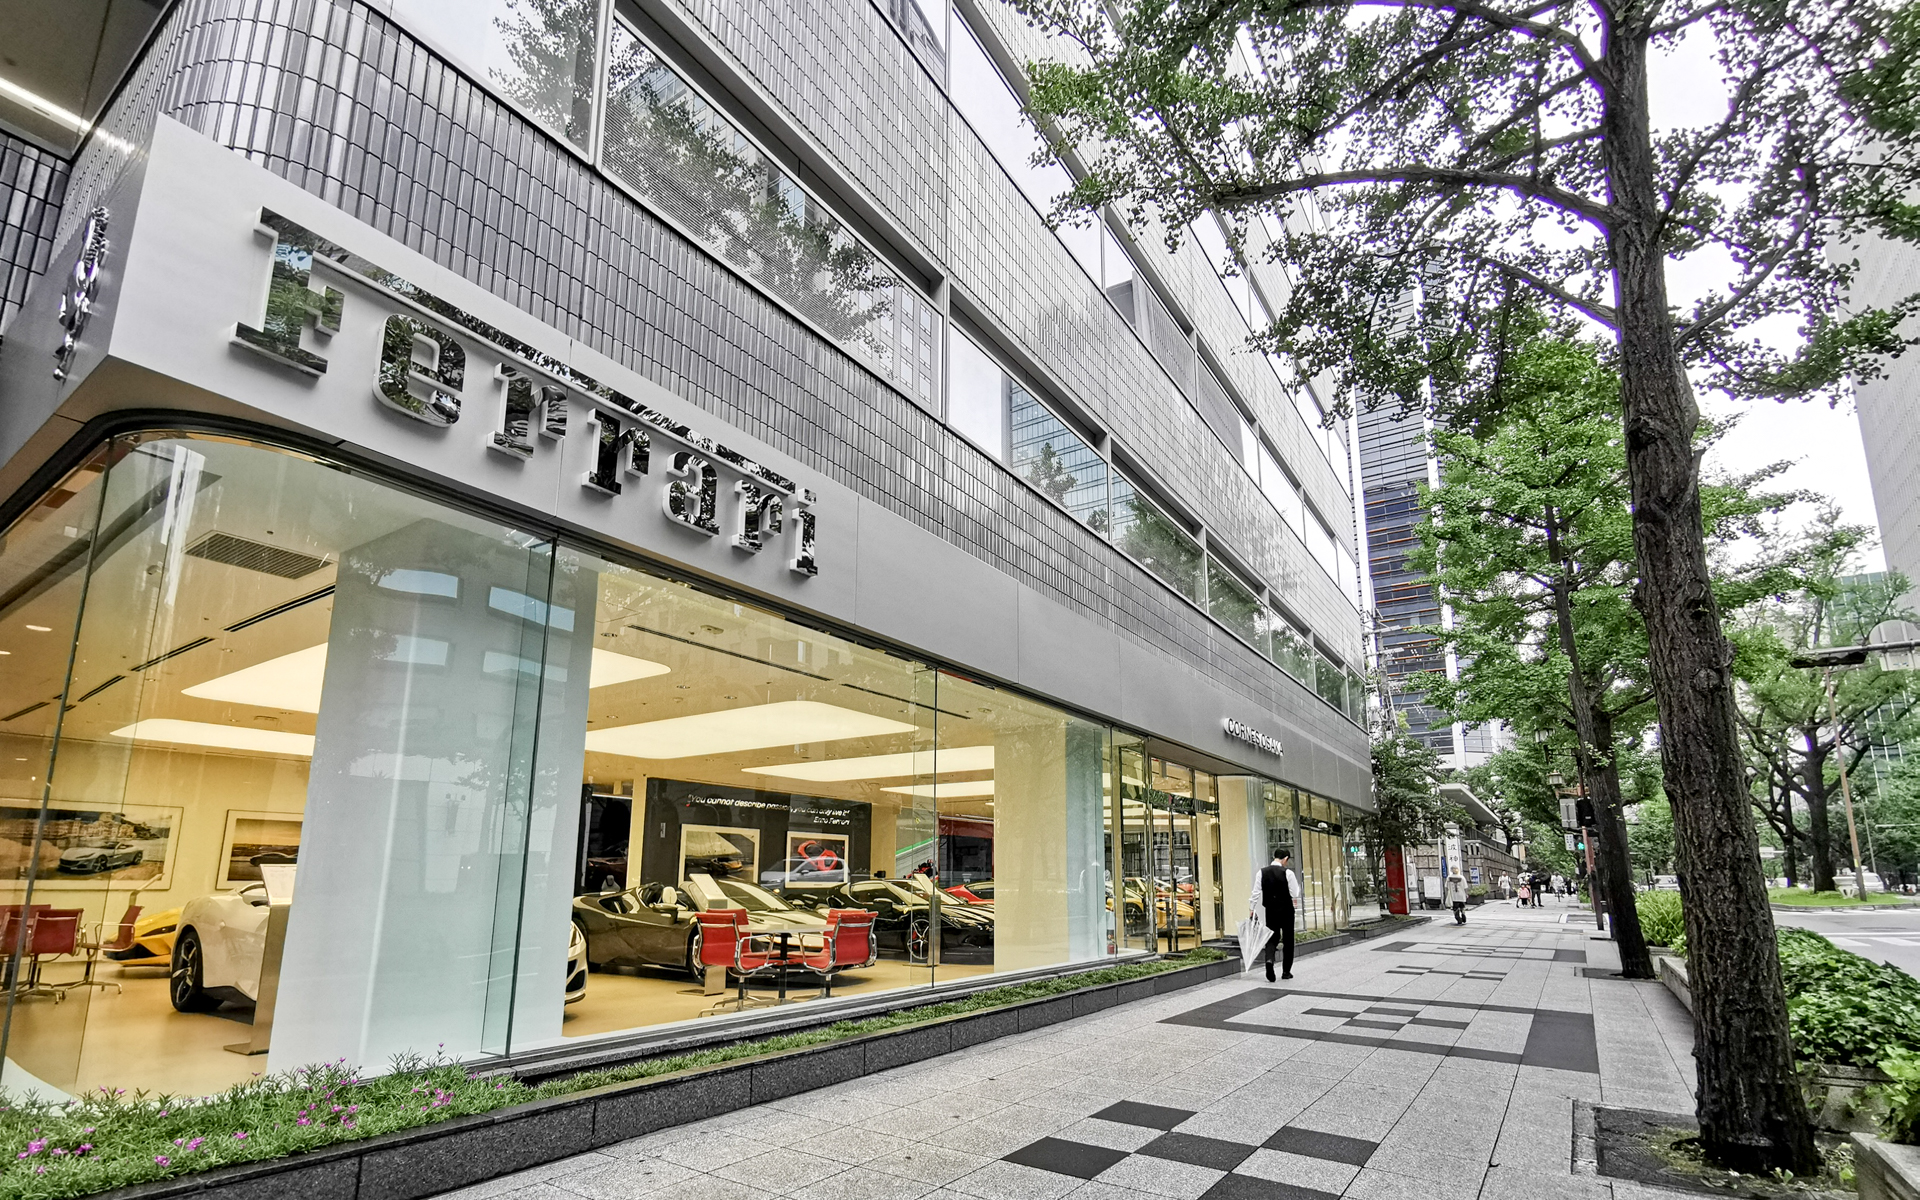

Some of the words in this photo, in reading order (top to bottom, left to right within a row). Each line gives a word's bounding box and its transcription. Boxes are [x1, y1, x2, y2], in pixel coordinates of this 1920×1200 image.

[229, 206, 819, 577] Ferrari
[1223, 717, 1260, 746] CORNES
[1259, 733, 1284, 757] OSAKA
[706, 797, 734, 806] cannot
[734, 799, 766, 809] describe
